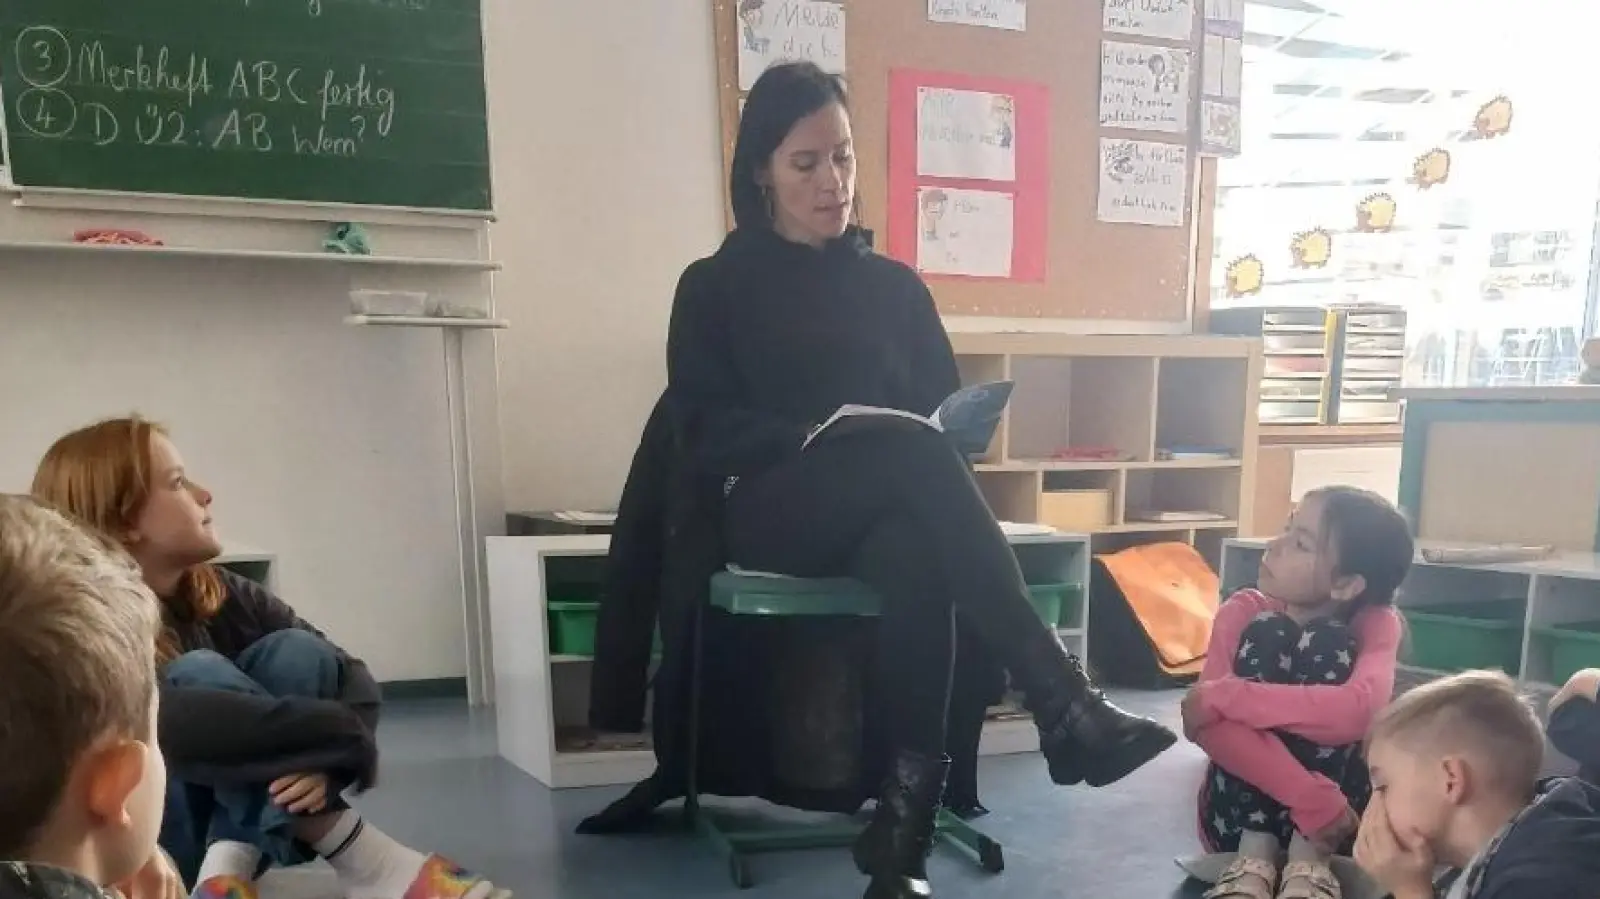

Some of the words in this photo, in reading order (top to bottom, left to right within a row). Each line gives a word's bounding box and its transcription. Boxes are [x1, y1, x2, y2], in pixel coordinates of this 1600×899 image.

[83, 102, 119, 145] D
[212, 108, 272, 151] AB
[229, 60, 307, 102] ABC
[318, 63, 395, 136] fertig
